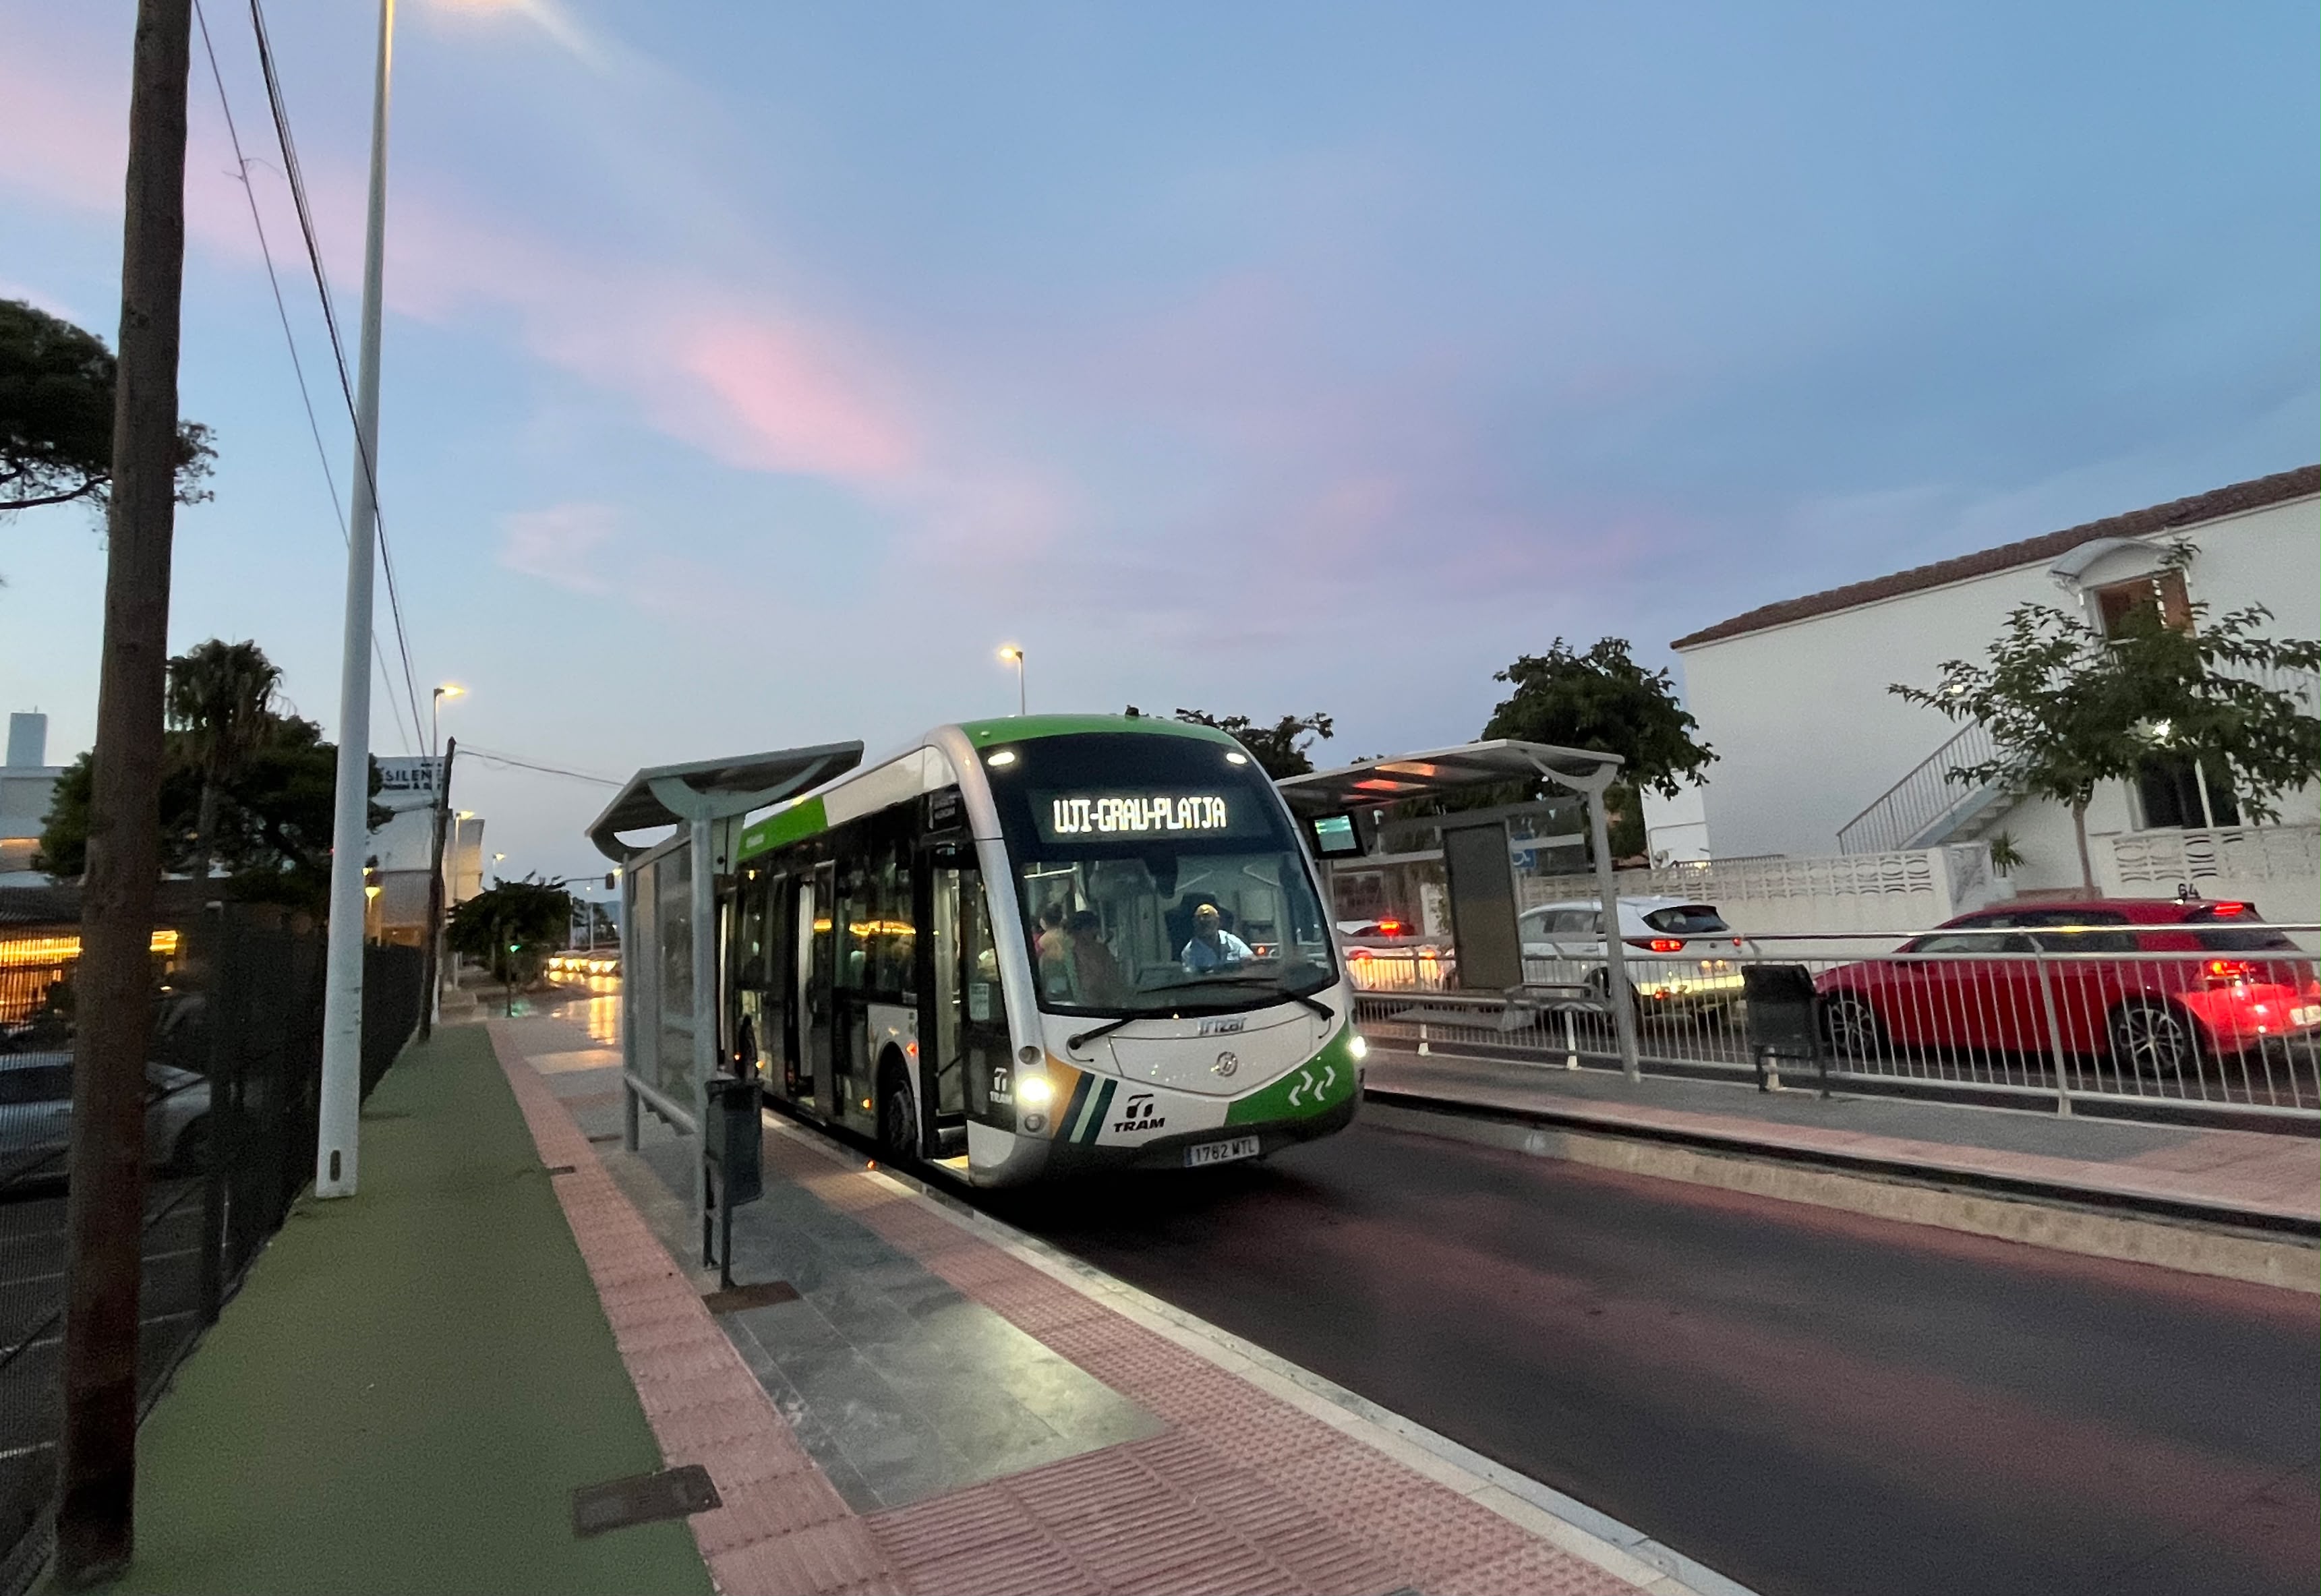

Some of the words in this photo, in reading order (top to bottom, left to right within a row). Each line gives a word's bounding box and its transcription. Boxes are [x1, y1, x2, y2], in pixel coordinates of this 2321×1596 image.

[385, 769, 442, 781] SILEN
[1053, 797, 1227, 833] UJI-GRAU-PLATJA
[2178, 883, 2201, 900] 64
[990, 1091, 1013, 1105] TRAM
[1113, 1117, 1166, 1133] TRAM
[1196, 1143, 1230, 1162] 1782
